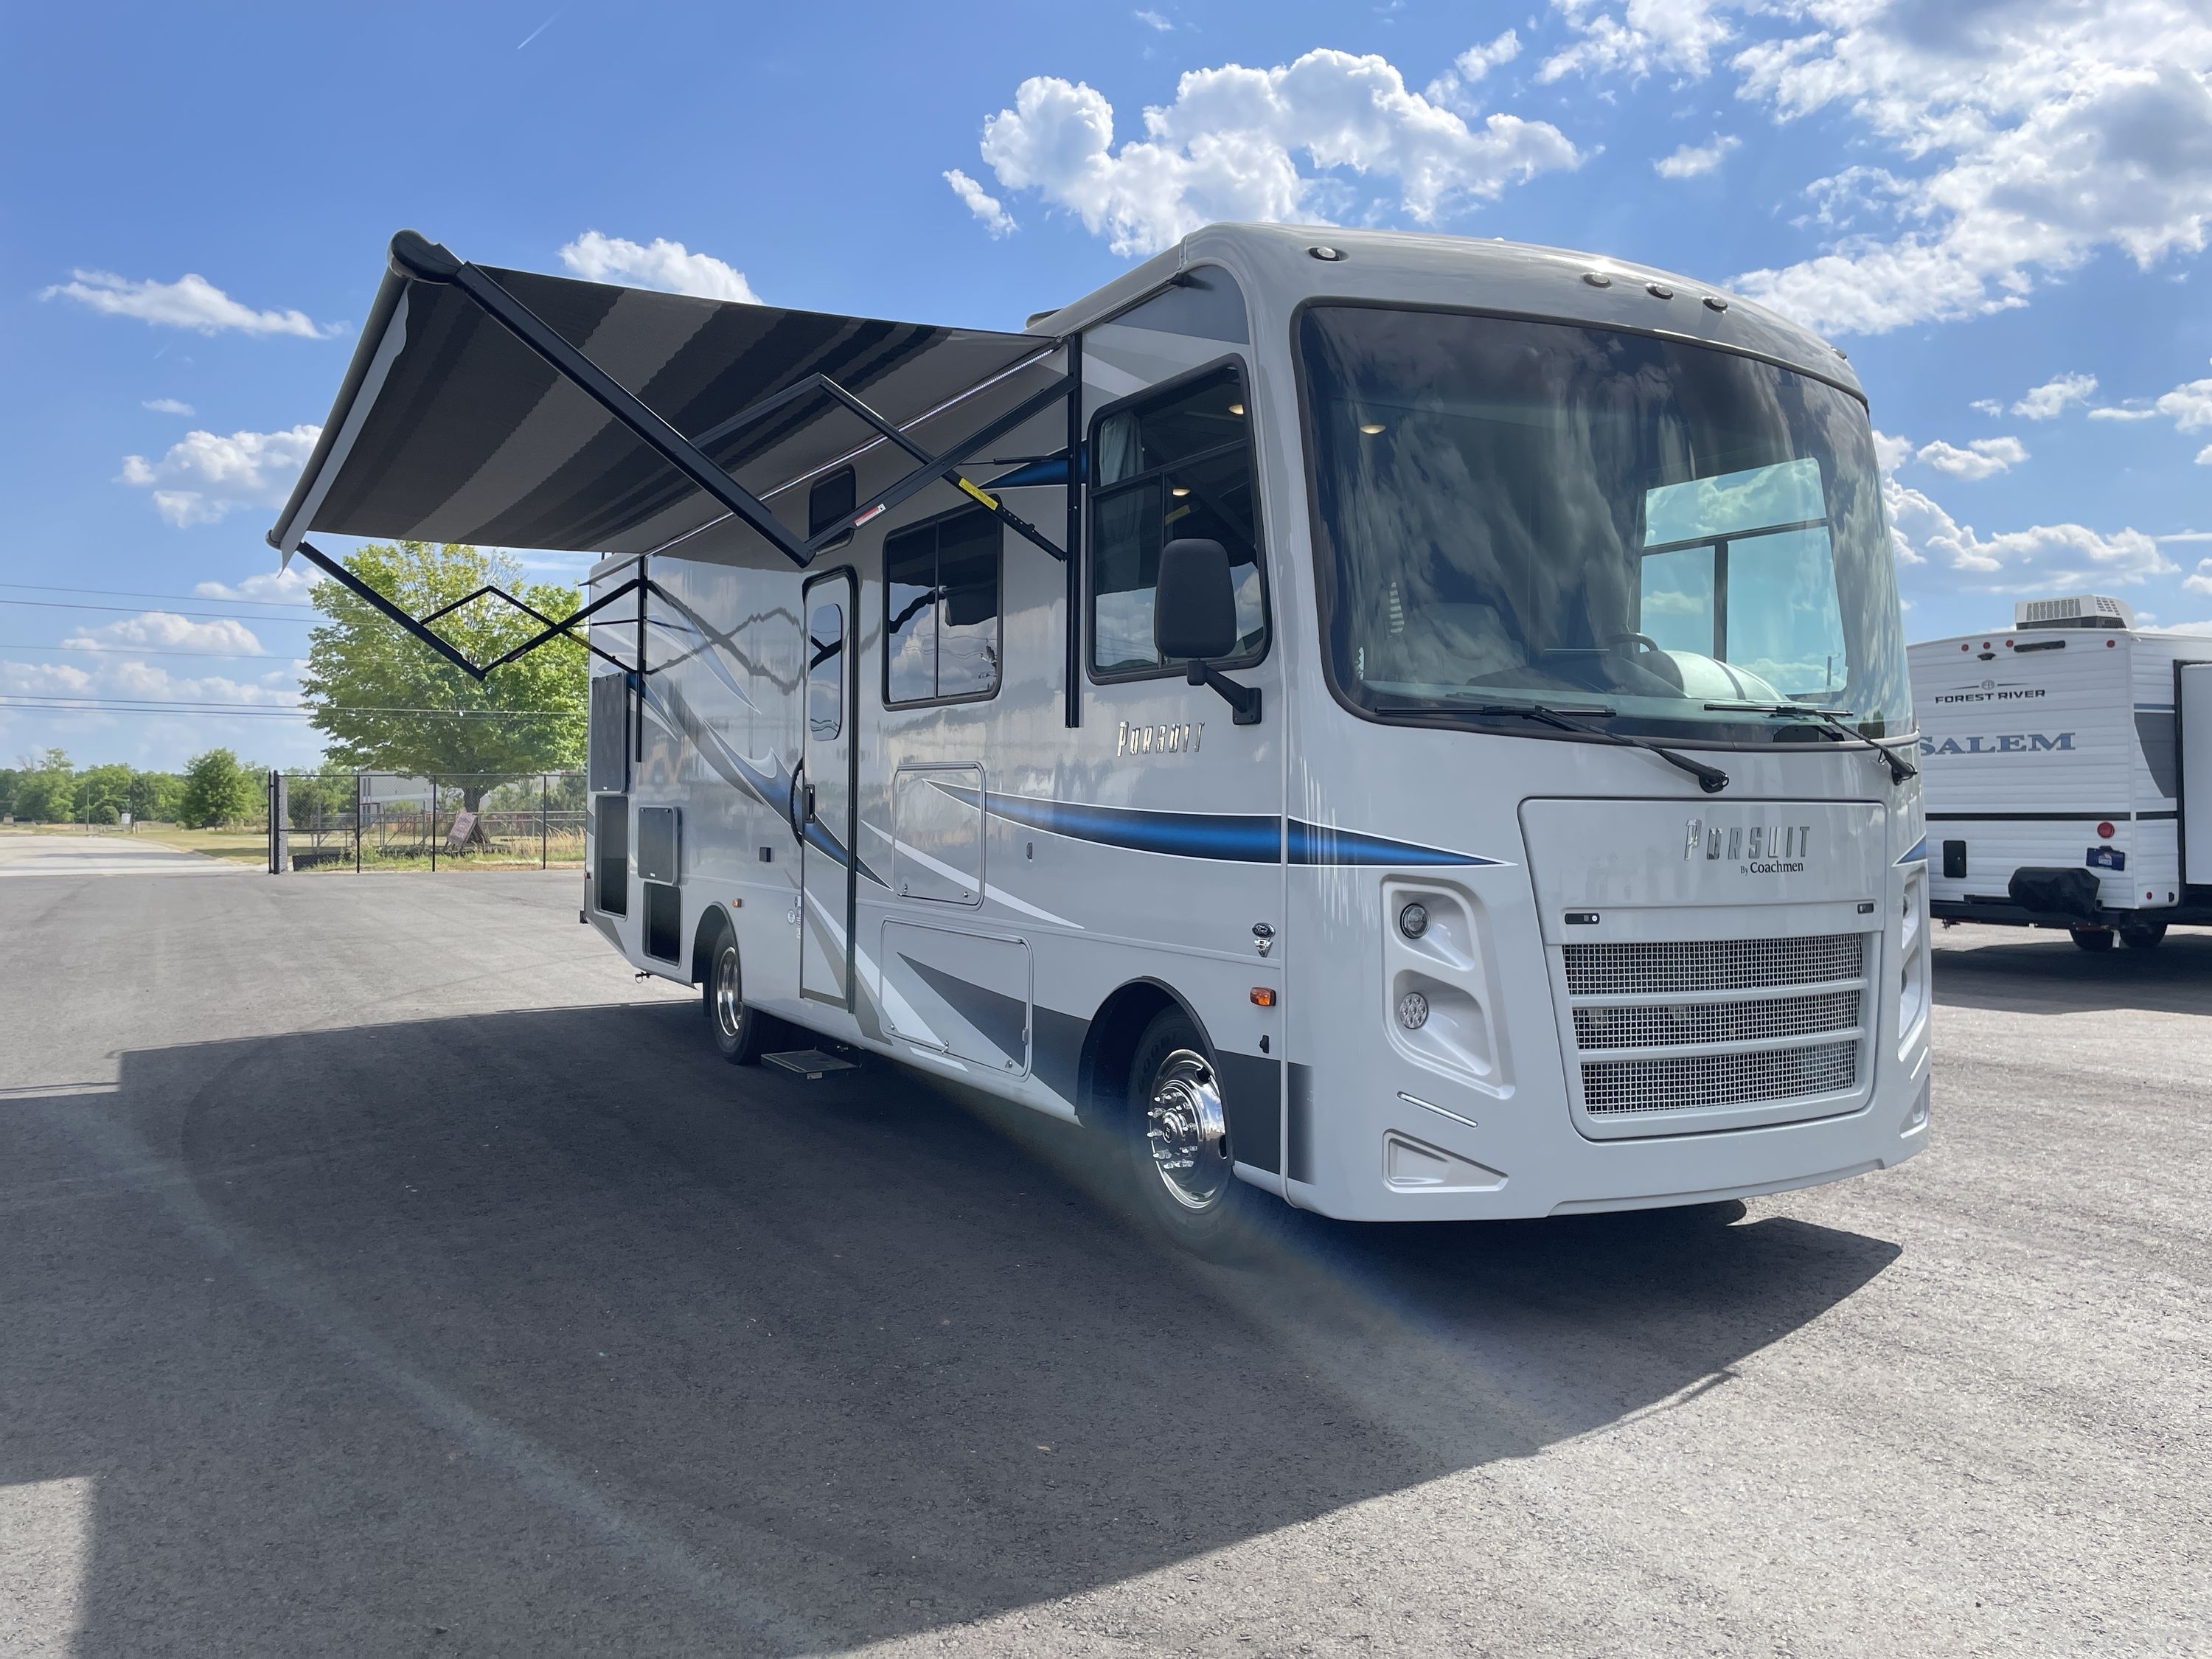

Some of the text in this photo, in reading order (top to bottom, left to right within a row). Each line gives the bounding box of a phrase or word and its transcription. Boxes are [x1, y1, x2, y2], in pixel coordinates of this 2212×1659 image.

[1935, 689, 2045, 703] FOREST RIVER
[1117, 721, 1205, 757] PURSUIT
[1919, 733, 2076, 757] SALEM
[1684, 819, 1810, 860] PURSUIT
[1741, 860, 1804, 876] By Coachmen
